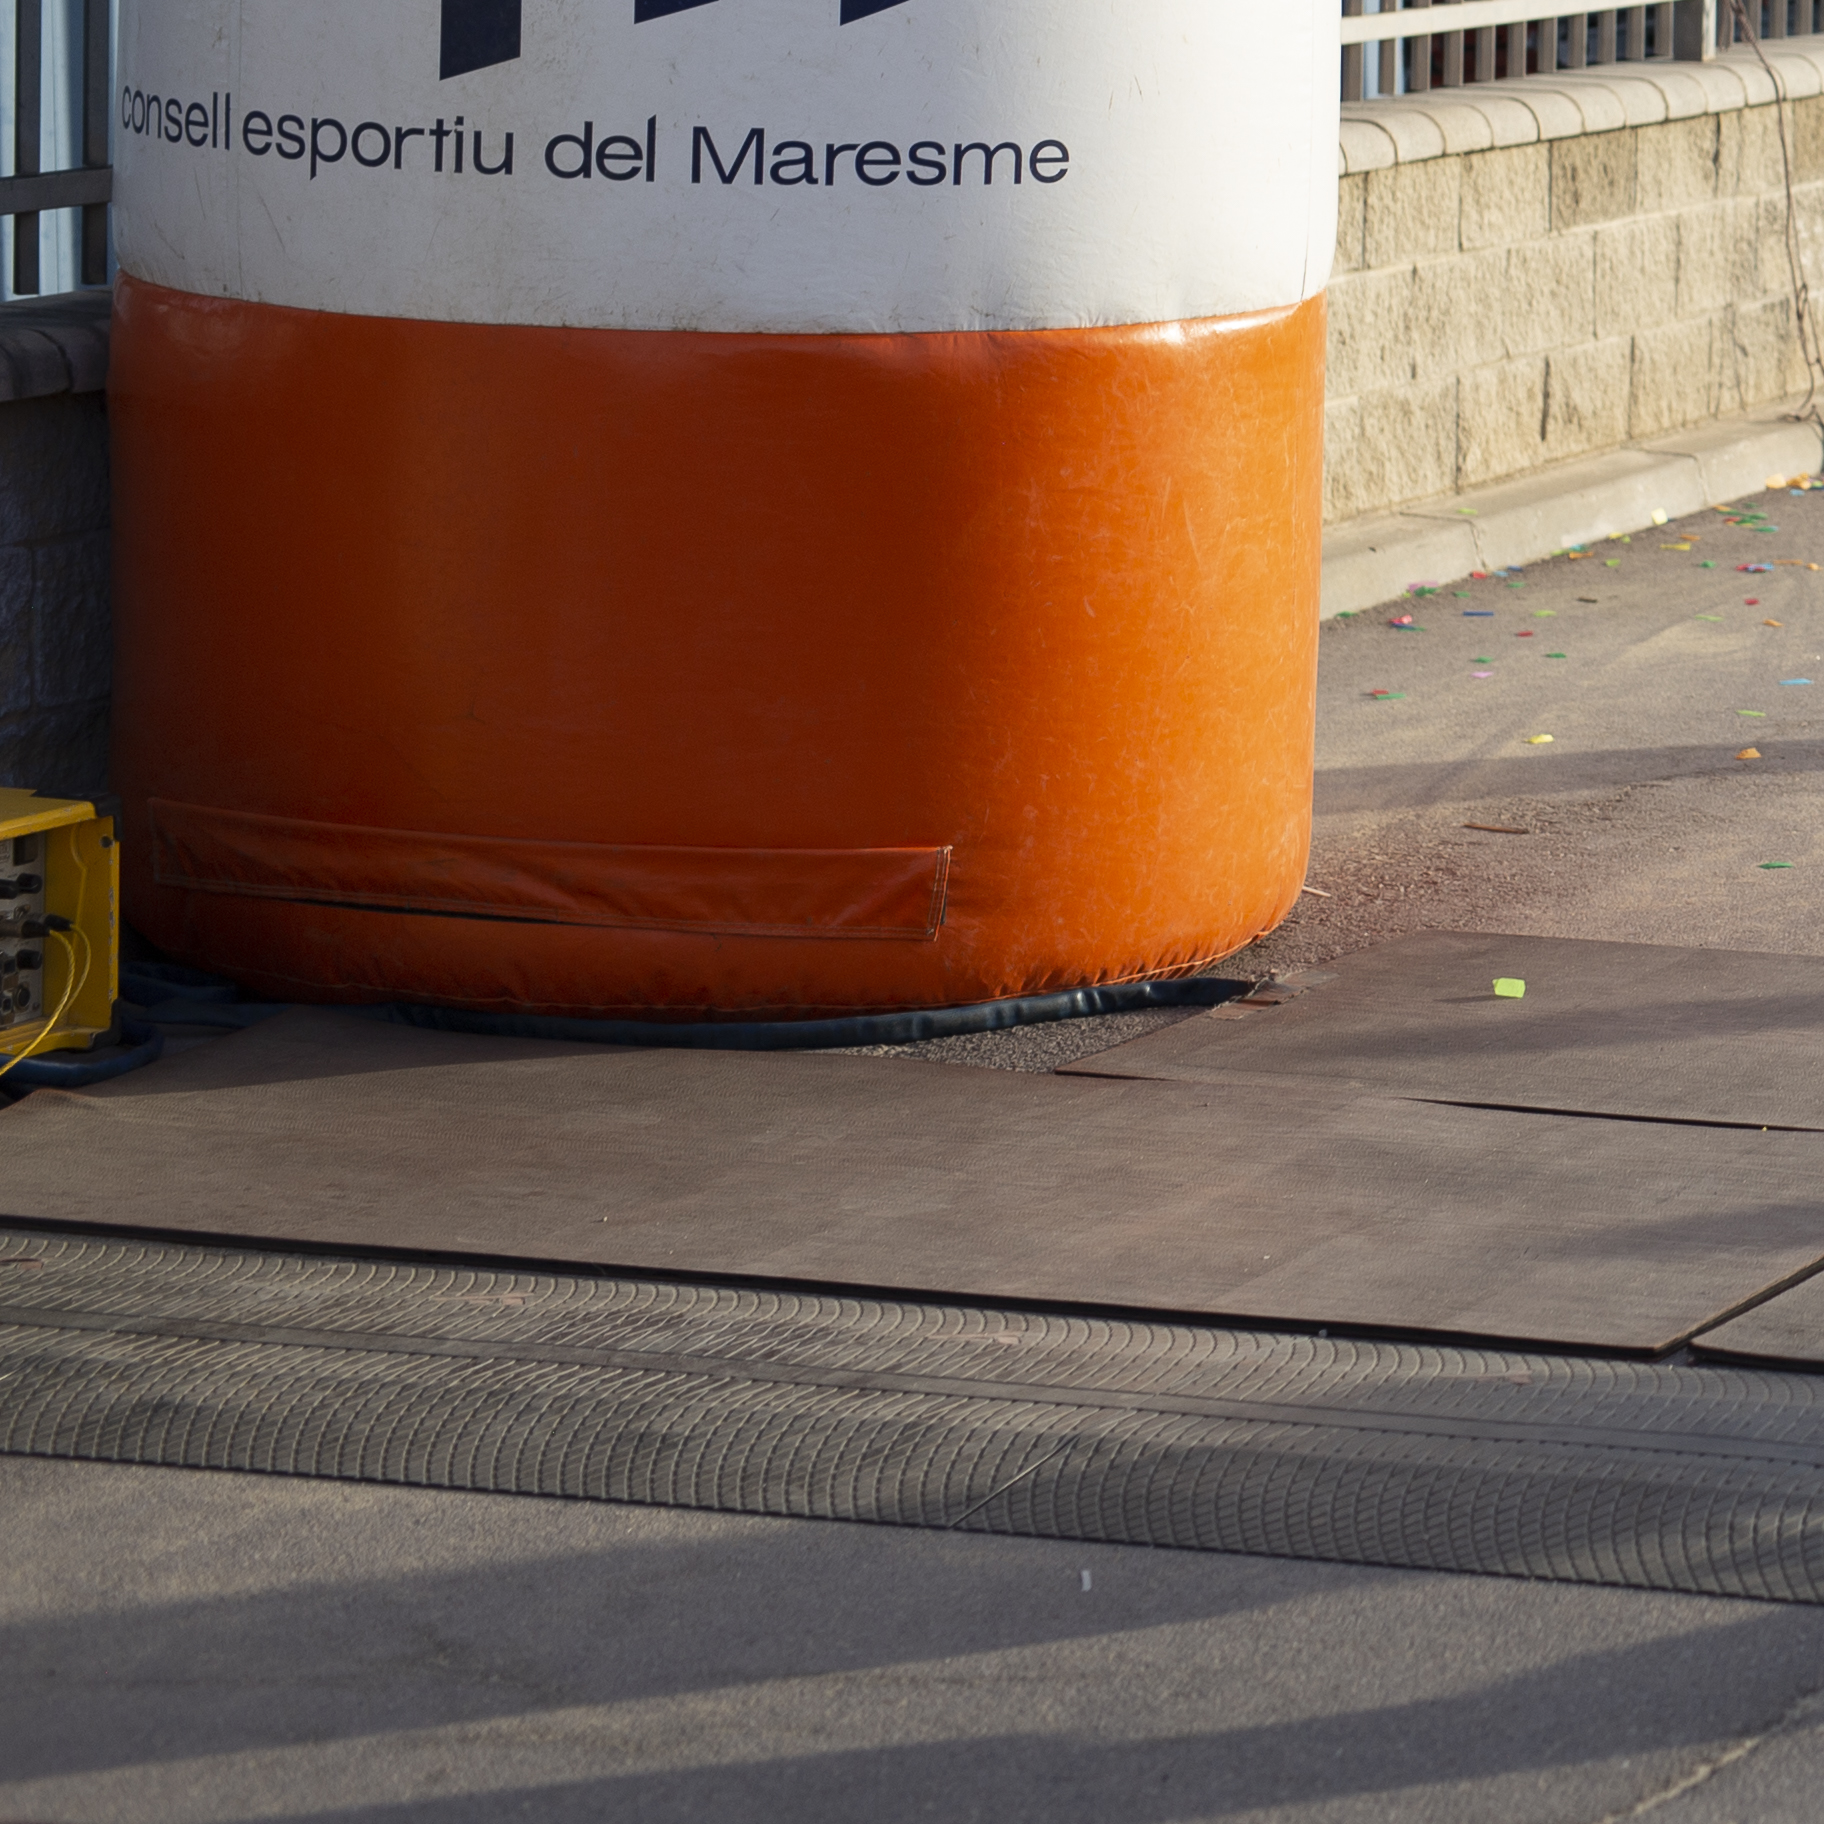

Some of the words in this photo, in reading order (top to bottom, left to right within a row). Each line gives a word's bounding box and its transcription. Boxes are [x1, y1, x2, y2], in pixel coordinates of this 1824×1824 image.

[121, 84, 232, 152] consell
[240, 108, 515, 182] esportiu
[543, 112, 658, 184] del
[690, 124, 1071, 188] Maresme
